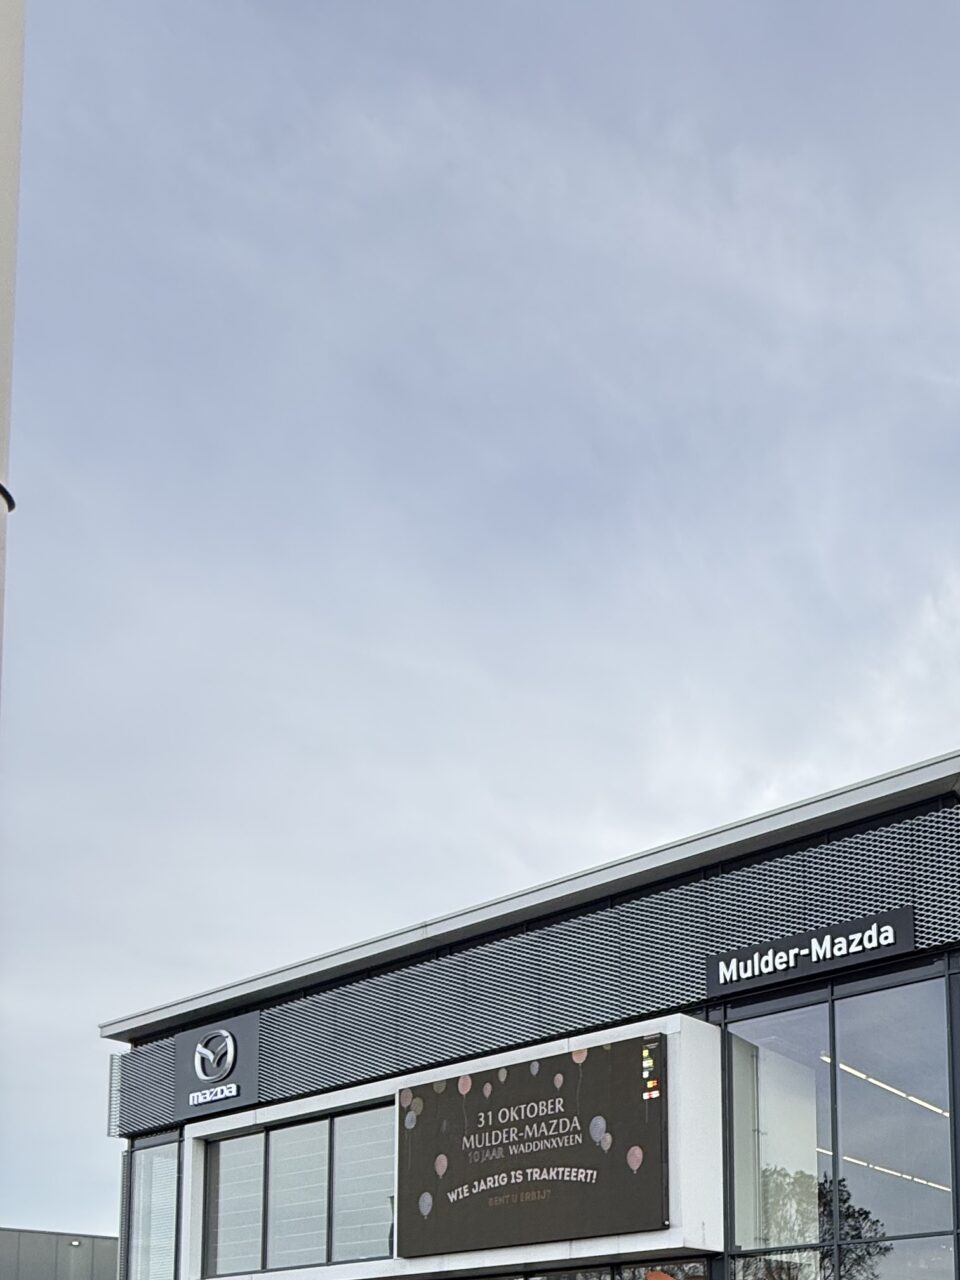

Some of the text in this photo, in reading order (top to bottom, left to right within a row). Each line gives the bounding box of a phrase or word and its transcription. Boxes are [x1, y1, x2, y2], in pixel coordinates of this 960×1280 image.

[719, 923, 895, 984] Mulder-Mazda
[189, 1083, 238, 1106] mazda
[477, 1097, 565, 1128] 31 OKTOBER
[462, 1116, 581, 1150] MULDER-MAZDA
[508, 1133, 583, 1155] WADDINXVEEN
[446, 1166, 598, 1204] WIE JARIG IS TRAKTEERT!
